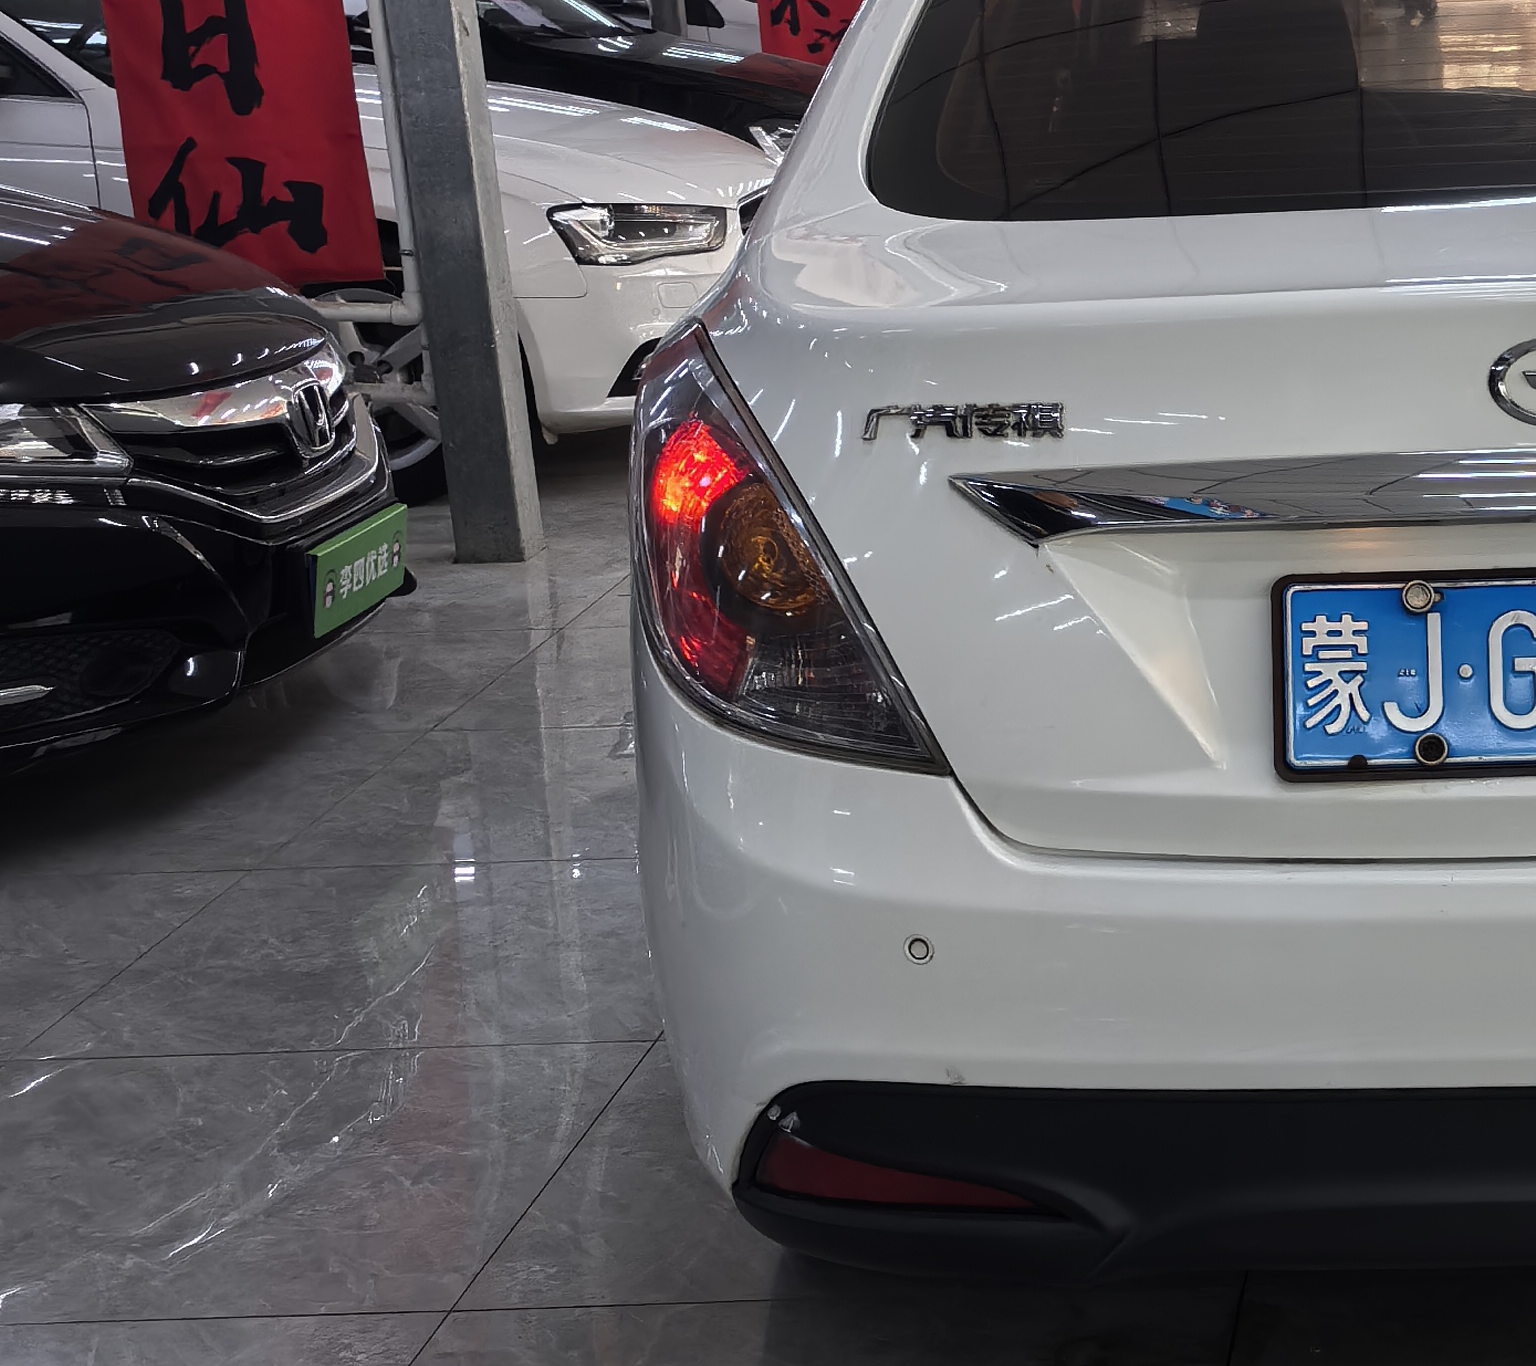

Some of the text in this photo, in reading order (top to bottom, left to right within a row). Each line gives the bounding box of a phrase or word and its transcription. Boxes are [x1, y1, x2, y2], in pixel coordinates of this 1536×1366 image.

[862, 403, 1065, 441] 广汽传祺
[339, 542, 389, 600] 李四优选
